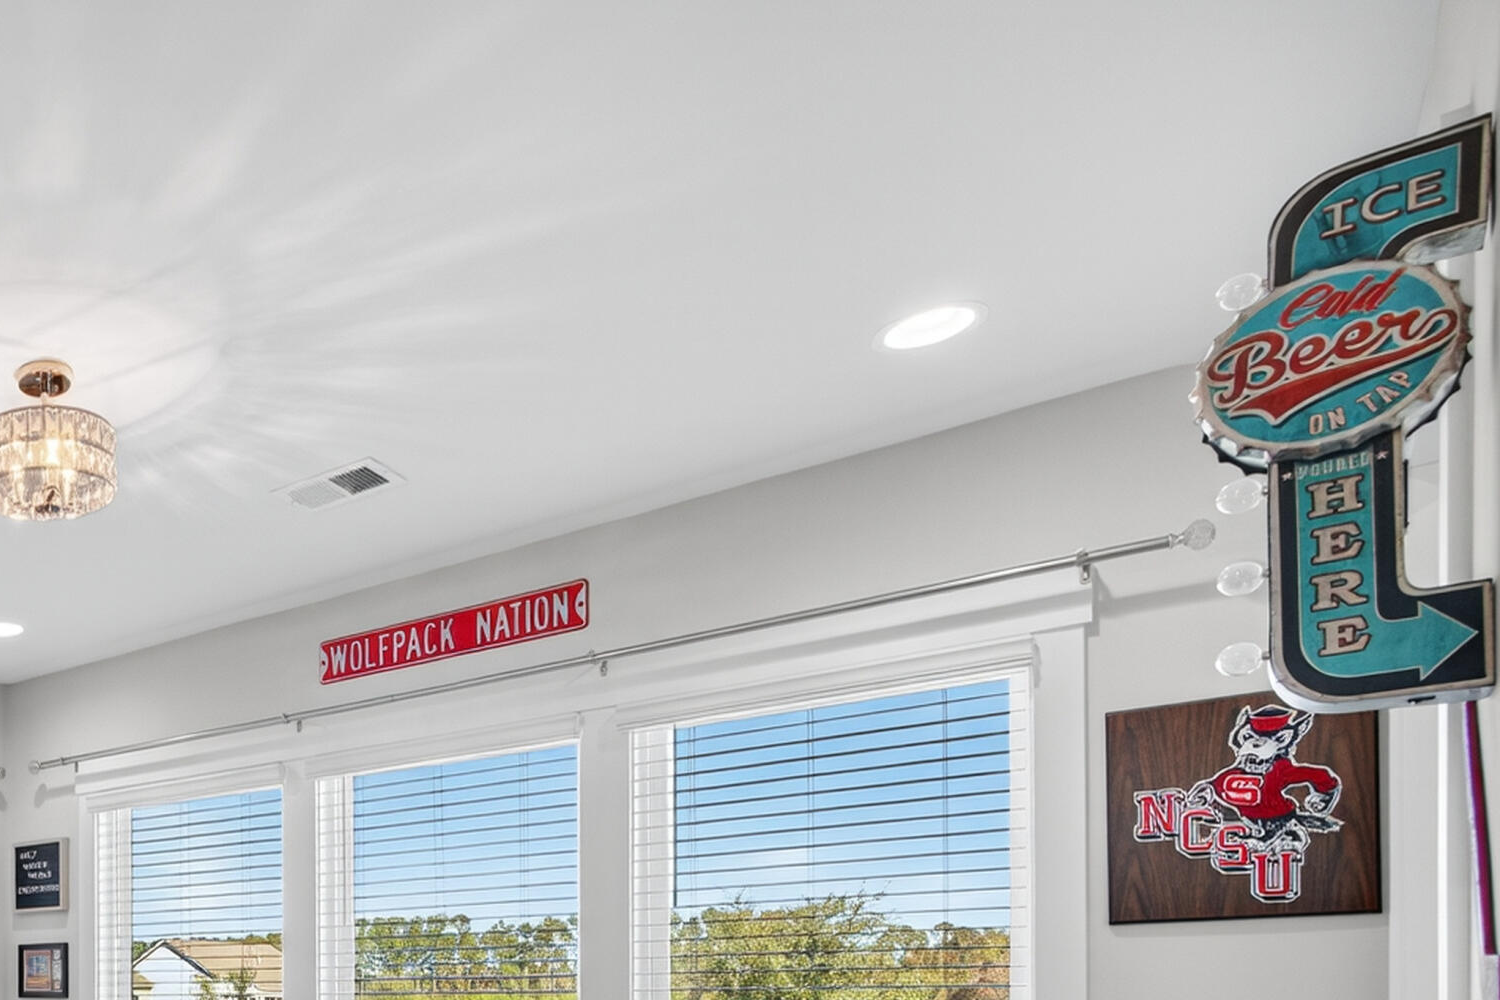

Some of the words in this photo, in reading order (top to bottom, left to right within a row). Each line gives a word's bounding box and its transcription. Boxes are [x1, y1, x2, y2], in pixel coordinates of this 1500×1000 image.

[1320, 168, 1447, 241] ICE
[1278, 266, 1407, 330] Cold
[1206, 308, 1458, 404] Beer
[1309, 407, 1346, 435] ON
[1355, 370, 1412, 413] TAP
[1306, 473, 1373, 658] HERE
[330, 617, 456, 676] WOLFPACK
[476, 590, 570, 645] NATION
[1134, 787, 1302, 904] NCSU
